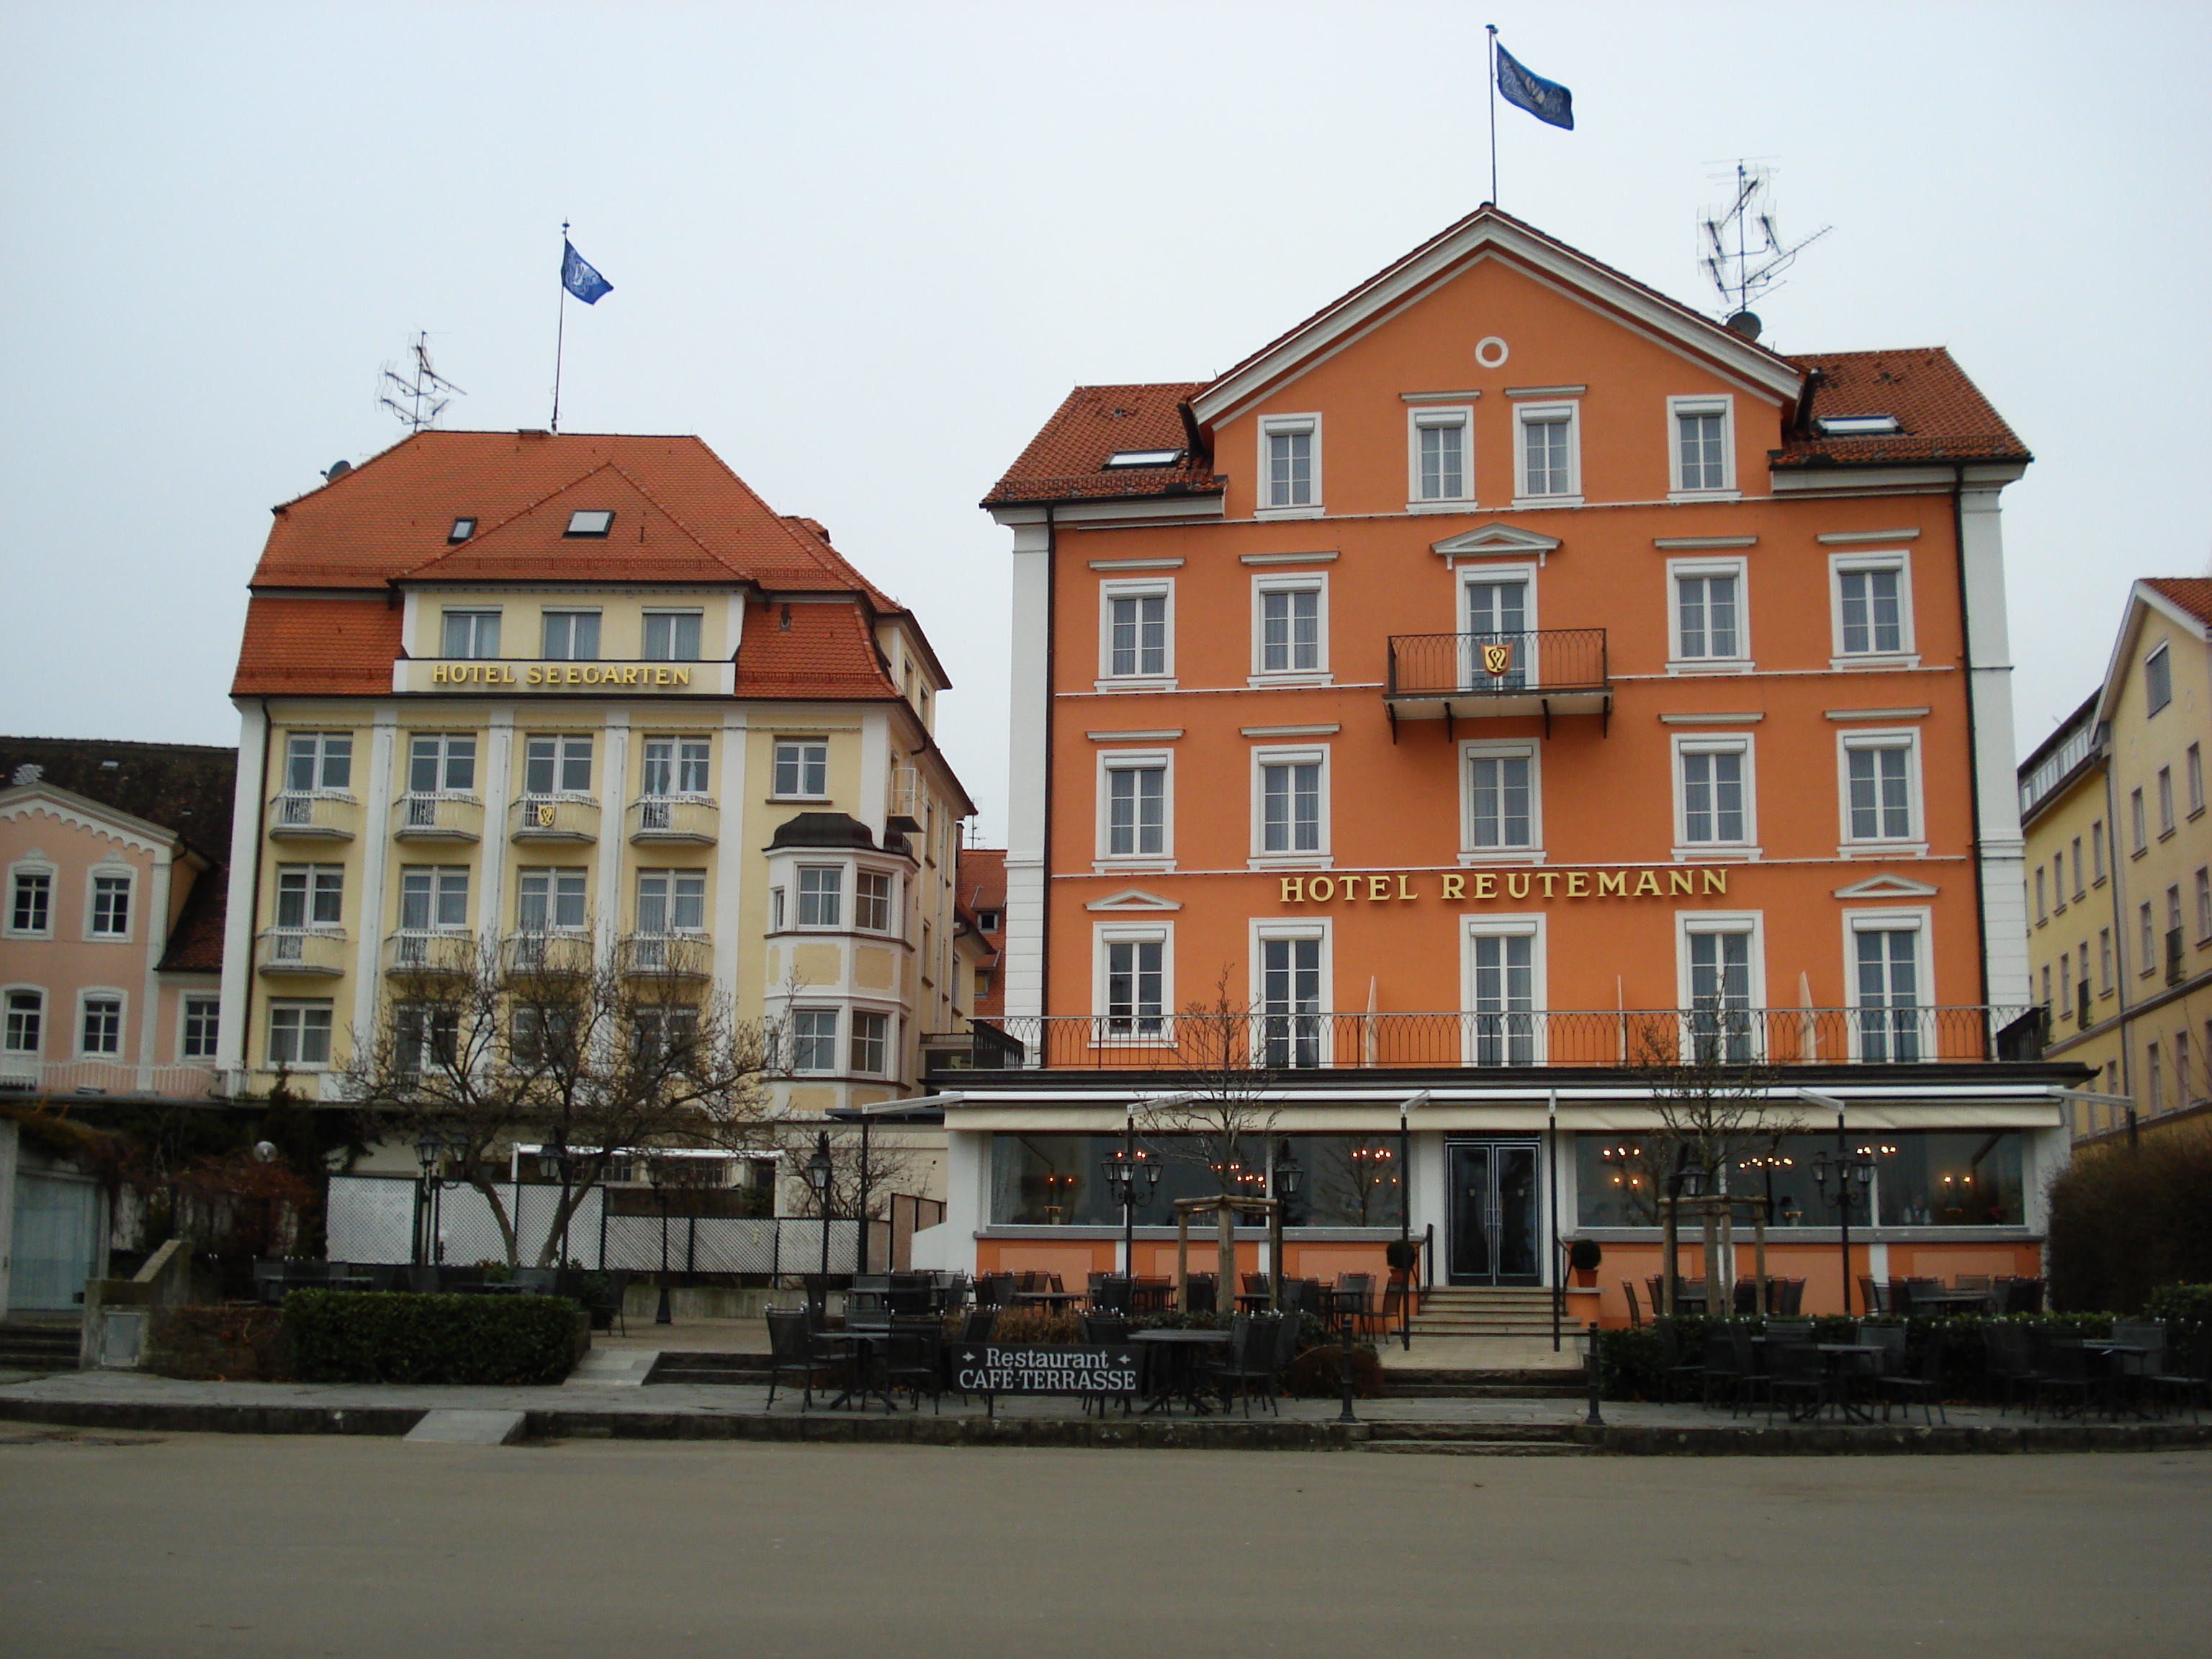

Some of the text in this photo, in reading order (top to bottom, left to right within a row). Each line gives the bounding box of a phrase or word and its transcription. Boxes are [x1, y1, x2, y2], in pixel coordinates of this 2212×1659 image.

[432, 664, 691, 685] HOTEL SEEGARTEN
[1279, 868, 1728, 903] HOTEL REUTEMANN
[985, 1347, 1110, 1369] Restaurant
[958, 1367, 1137, 1390] CAFÉ-TERRASSE
